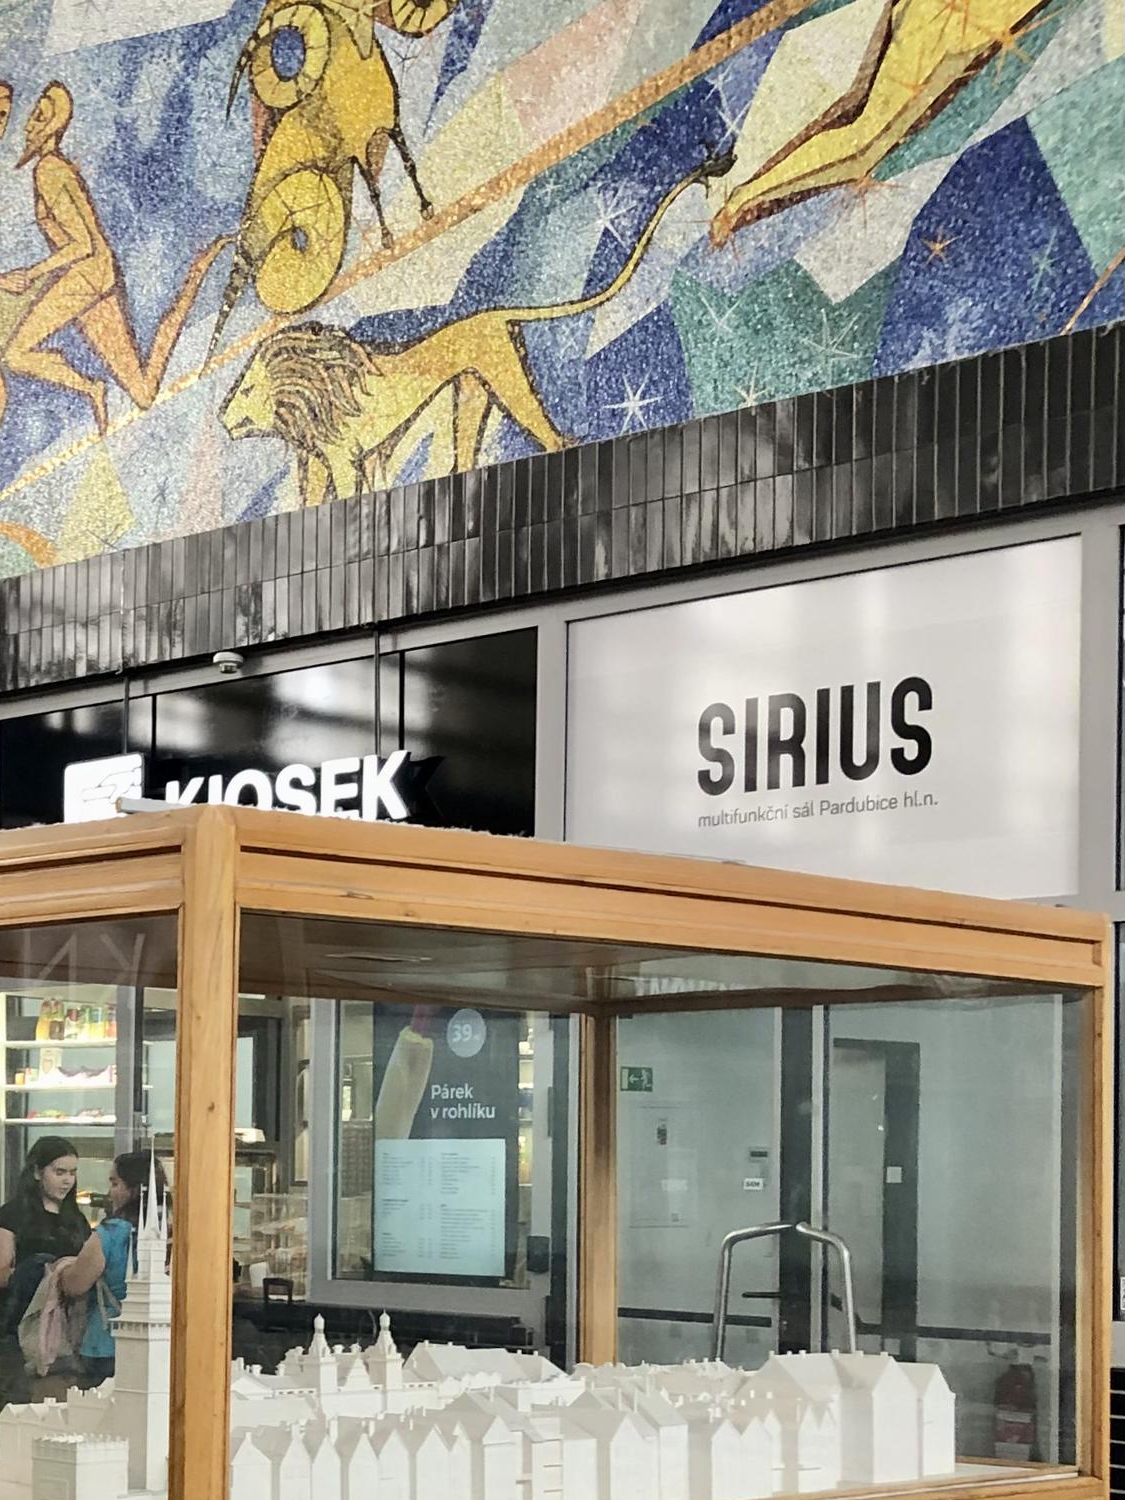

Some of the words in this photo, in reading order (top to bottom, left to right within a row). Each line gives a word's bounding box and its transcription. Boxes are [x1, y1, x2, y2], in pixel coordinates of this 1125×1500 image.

[698, 677, 933, 797] SIRIUS
[698, 804, 788, 828] multifunkční
[792, 803, 814, 819] sál
[820, 796, 898, 816] Pardubice
[903, 790, 939, 808] hl.n.
[431, 1083, 474, 1101] Párek
[430, 1108, 438, 1119] v
[442, 1103, 496, 1120] rohlíku
